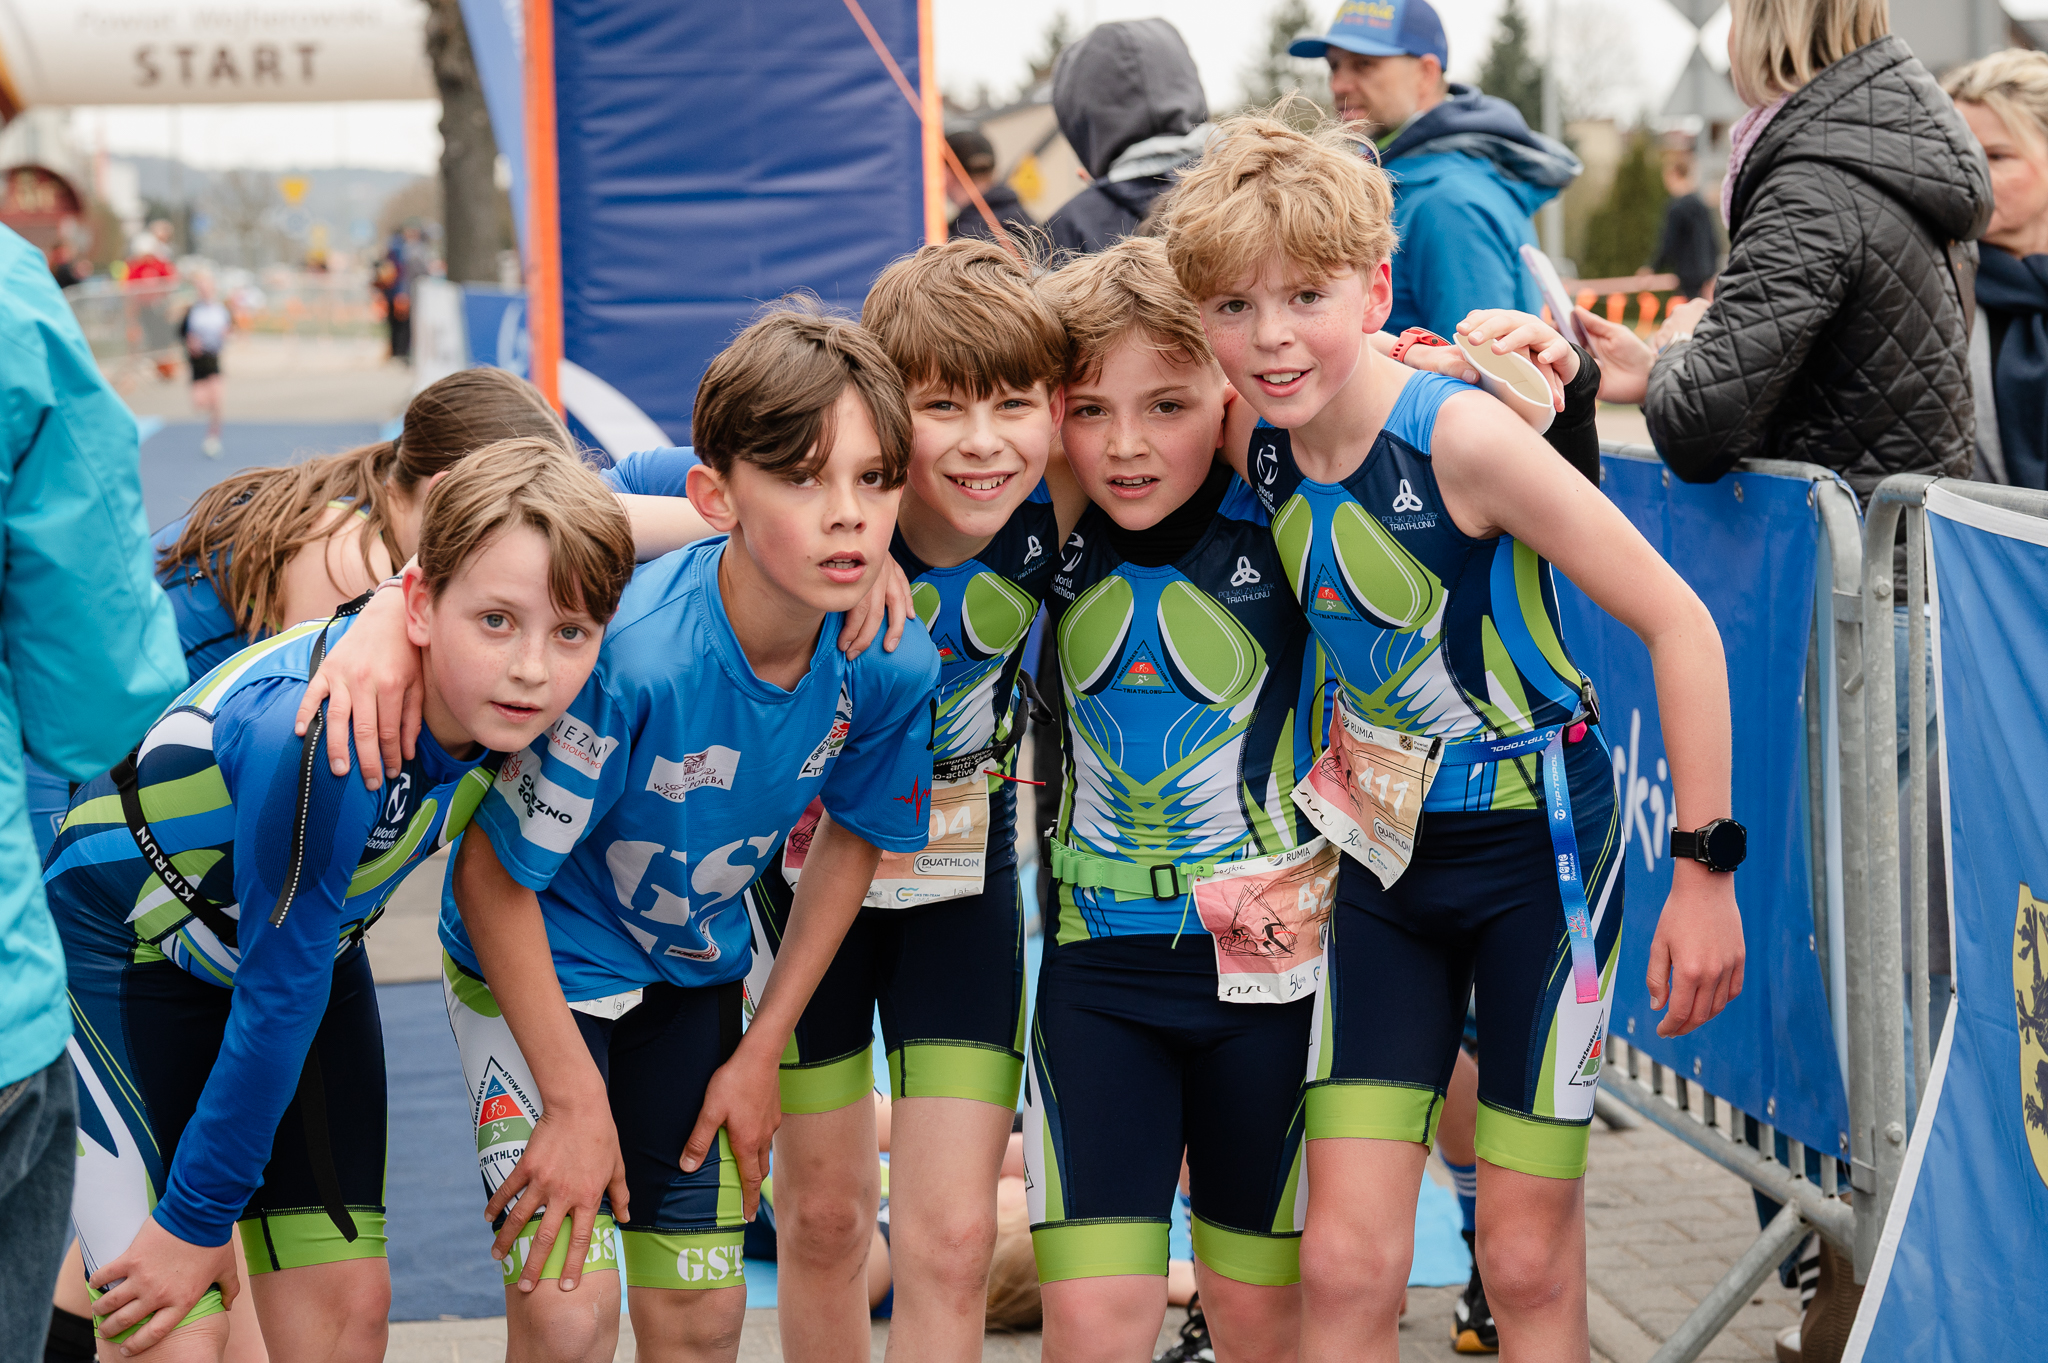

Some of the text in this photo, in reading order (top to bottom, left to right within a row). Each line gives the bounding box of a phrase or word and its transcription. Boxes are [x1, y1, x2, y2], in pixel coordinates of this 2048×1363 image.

[133, 43, 319, 88] START
[1381, 515, 1405, 524] POLSKI
[1389, 520, 1436, 531] TRIATHLONU
[1226, 590, 1270, 604] TRIATHLONU
[556, 720, 608, 758] IEZN
[1350, 722, 1374, 740] RUMIA
[561, 742, 590, 764] STOLICA
[1358, 767, 1409, 817] 411
[373, 826, 399, 839] World
[929, 806, 974, 842] 04
[1378, 825, 1411, 853] DUATHLON
[136, 826, 195, 902] KIPRUN
[922, 858, 979, 867] DUATHLON
[1286, 847, 1311, 862] RUMIA
[502, 1071, 540, 1122] STOWARZYSZ
[480, 1148, 524, 1167] TRIATHLON
[677, 1244, 744, 1282] GST
